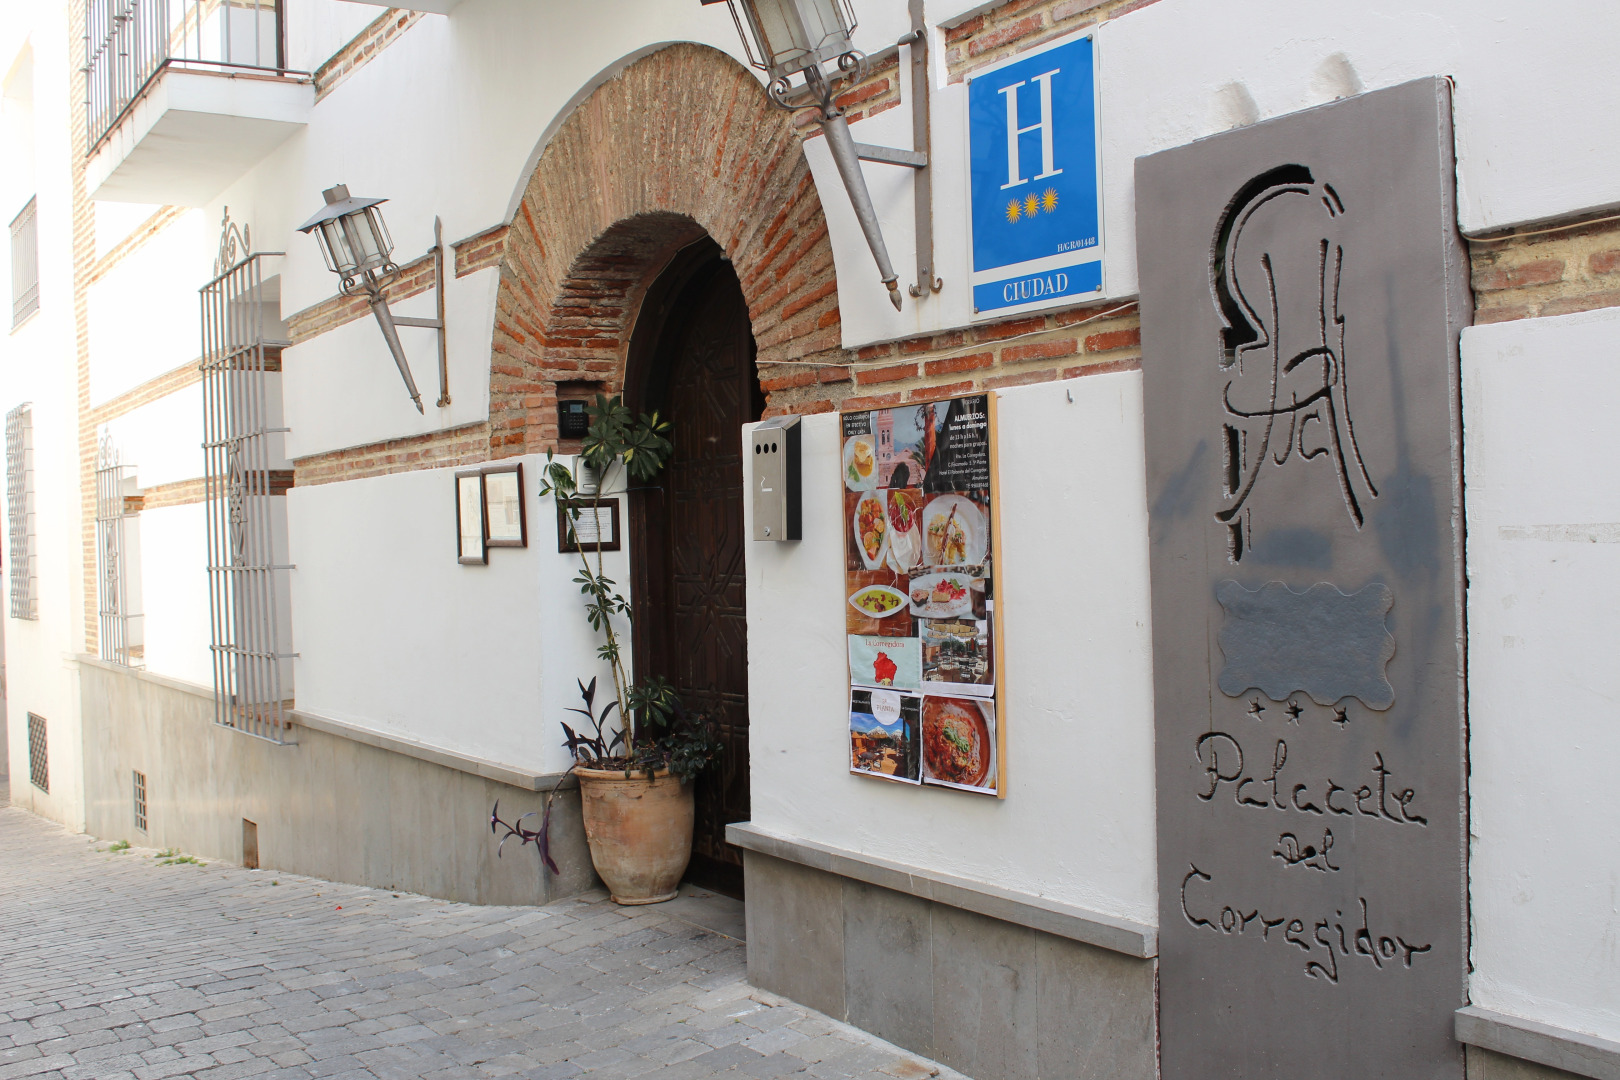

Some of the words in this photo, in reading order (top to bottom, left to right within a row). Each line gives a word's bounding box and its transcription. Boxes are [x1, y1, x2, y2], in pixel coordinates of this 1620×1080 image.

[998, 68, 1063, 190] H
[1003, 272, 1069, 302] CIUDAD
[949, 423, 961, 431] lunes
[966, 420, 987, 430] domingo
[954, 411, 986, 422] ALMUERZOS:
[865, 638, 871, 646] La
[873, 638, 905, 648] Corregidora
[1195, 731, 1428, 827] Palacete
[1181, 862, 1432, 985] Corregidor
